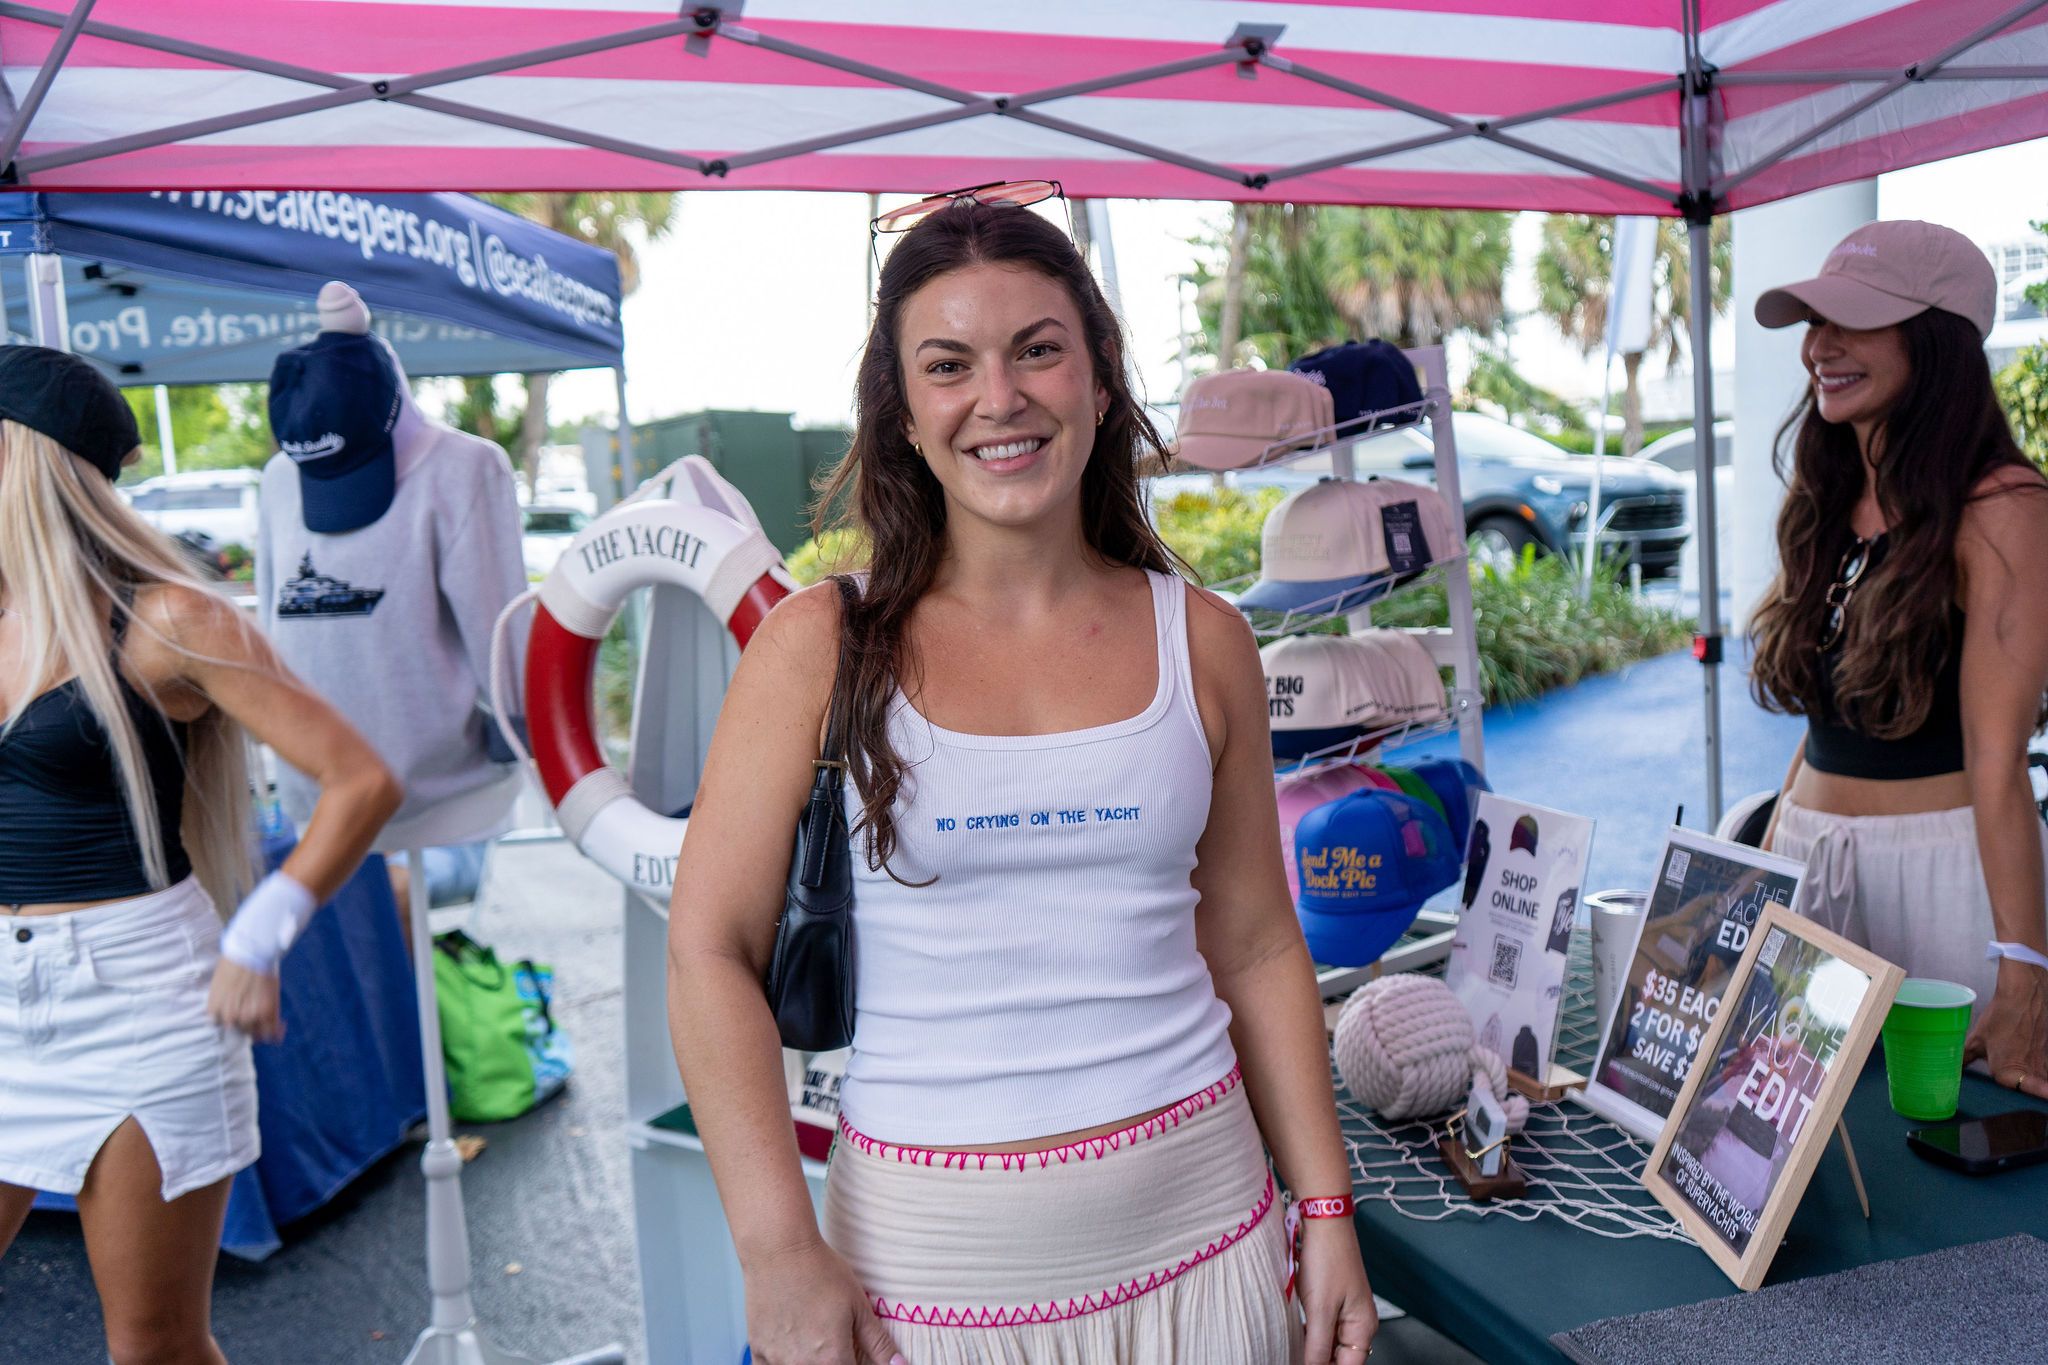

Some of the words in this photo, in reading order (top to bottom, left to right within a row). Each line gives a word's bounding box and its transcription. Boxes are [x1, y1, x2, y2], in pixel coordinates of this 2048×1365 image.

[579, 528, 625, 574] THE
[626, 523, 708, 569] YACHT
[1276, 675, 1304, 695] BIG
[936, 818, 956, 832] NO
[966, 814, 1020, 831] CRYING
[1030, 811, 1050, 827] ON
[1057, 810, 1087, 825] THE
[1095, 807, 1141, 822] YACHT
[1331, 846, 1366, 869] Me
[1368, 854, 1382, 869] a
[1340, 868, 1376, 890] Pic
[1500, 868, 1538, 893] SHOP
[1753, 880, 1789, 905] THE
[1491, 890, 1541, 920] ONLINE
[1642, 967, 1680, 1007] $35
[1630, 1001, 1645, 1028] 2
[1645, 1007, 1685, 1047] FOR
[1632, 1037, 1677, 1074] SAVE
[1741, 995, 1839, 1094] YACHT
[1736, 1058, 1814, 1145] EDIT
[1671, 1141, 1704, 1181] INSPIRED
[1701, 1170, 1715, 1191] BY
[1712, 1180, 1730, 1207] THE
[1304, 1198, 1345, 1217] YATCO
[1676, 1167, 1689, 1187] OF
[1685, 1177, 1739, 1241] SUPERYACHTS
